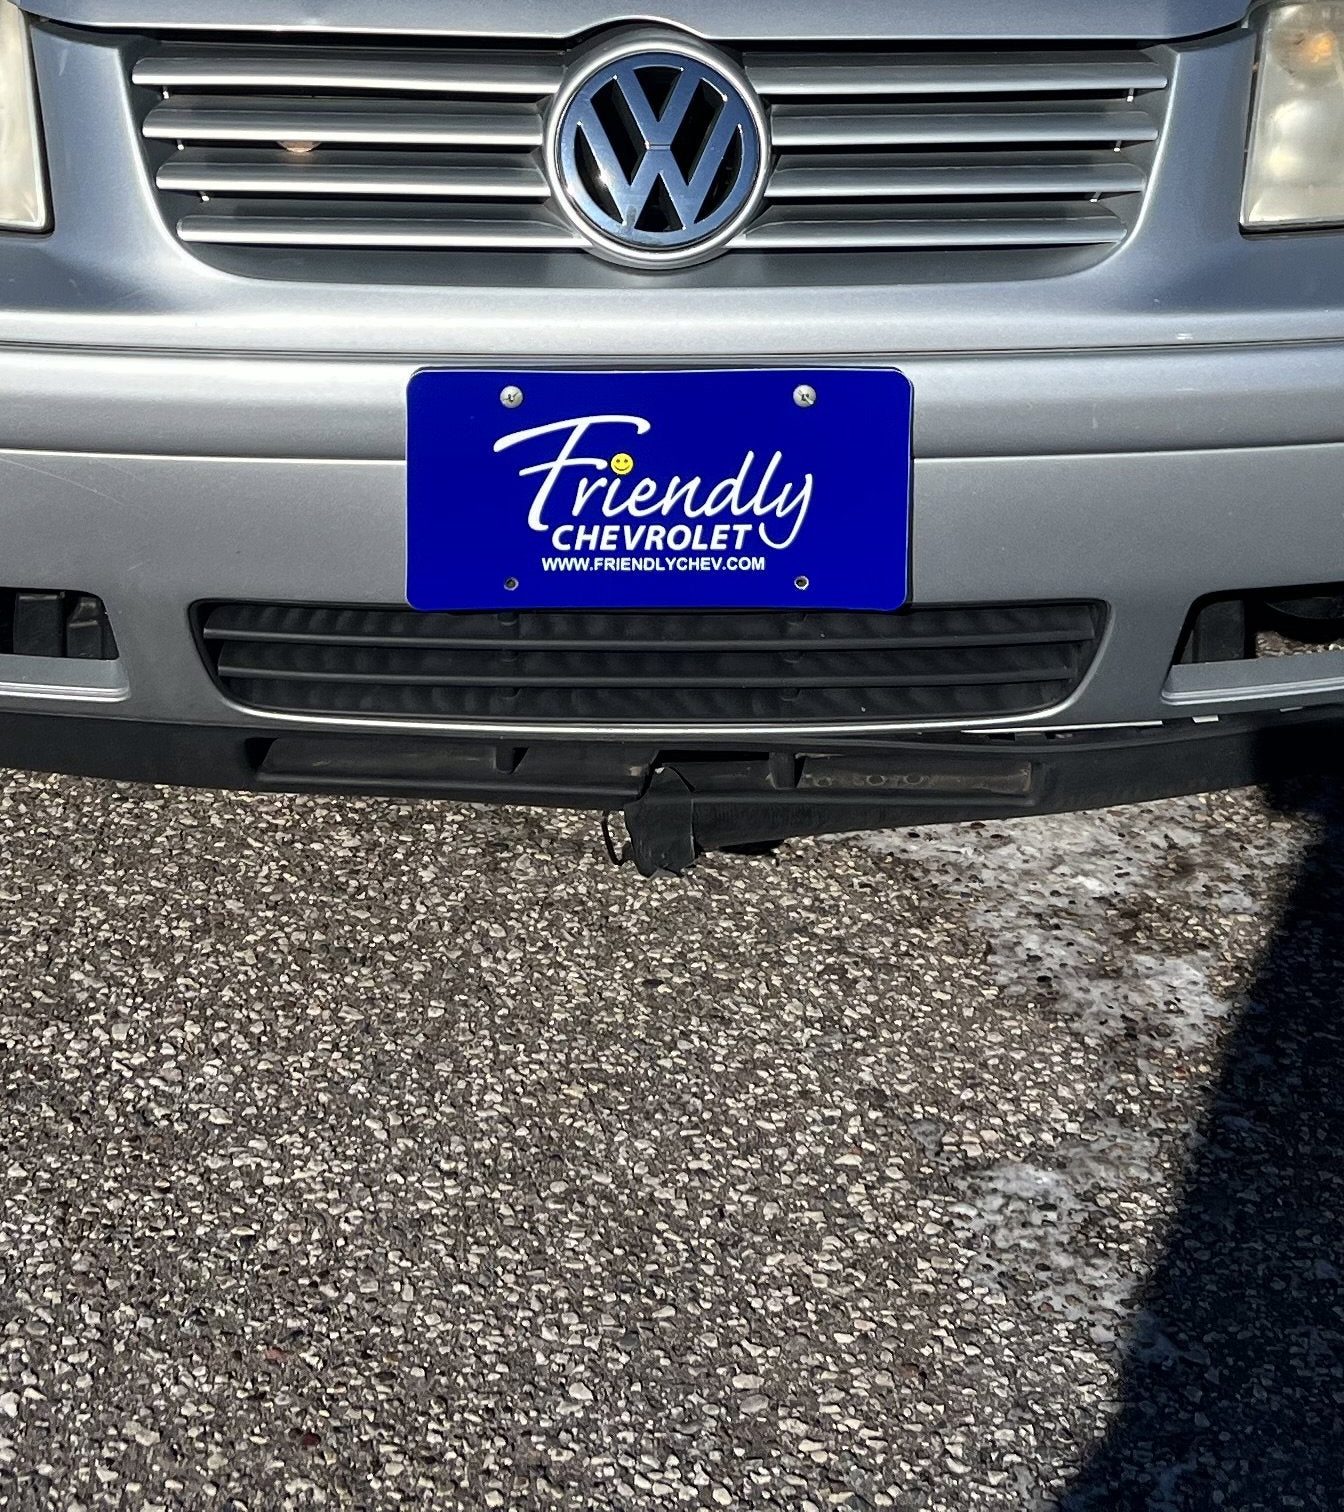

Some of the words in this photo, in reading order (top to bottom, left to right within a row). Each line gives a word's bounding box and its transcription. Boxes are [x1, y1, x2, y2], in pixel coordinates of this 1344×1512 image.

[493, 414, 813, 550] Friendly
[551, 523, 753, 552] CHEVROLET
[541, 556, 766, 572] WWW.FRIENDLYCHEV.COM
